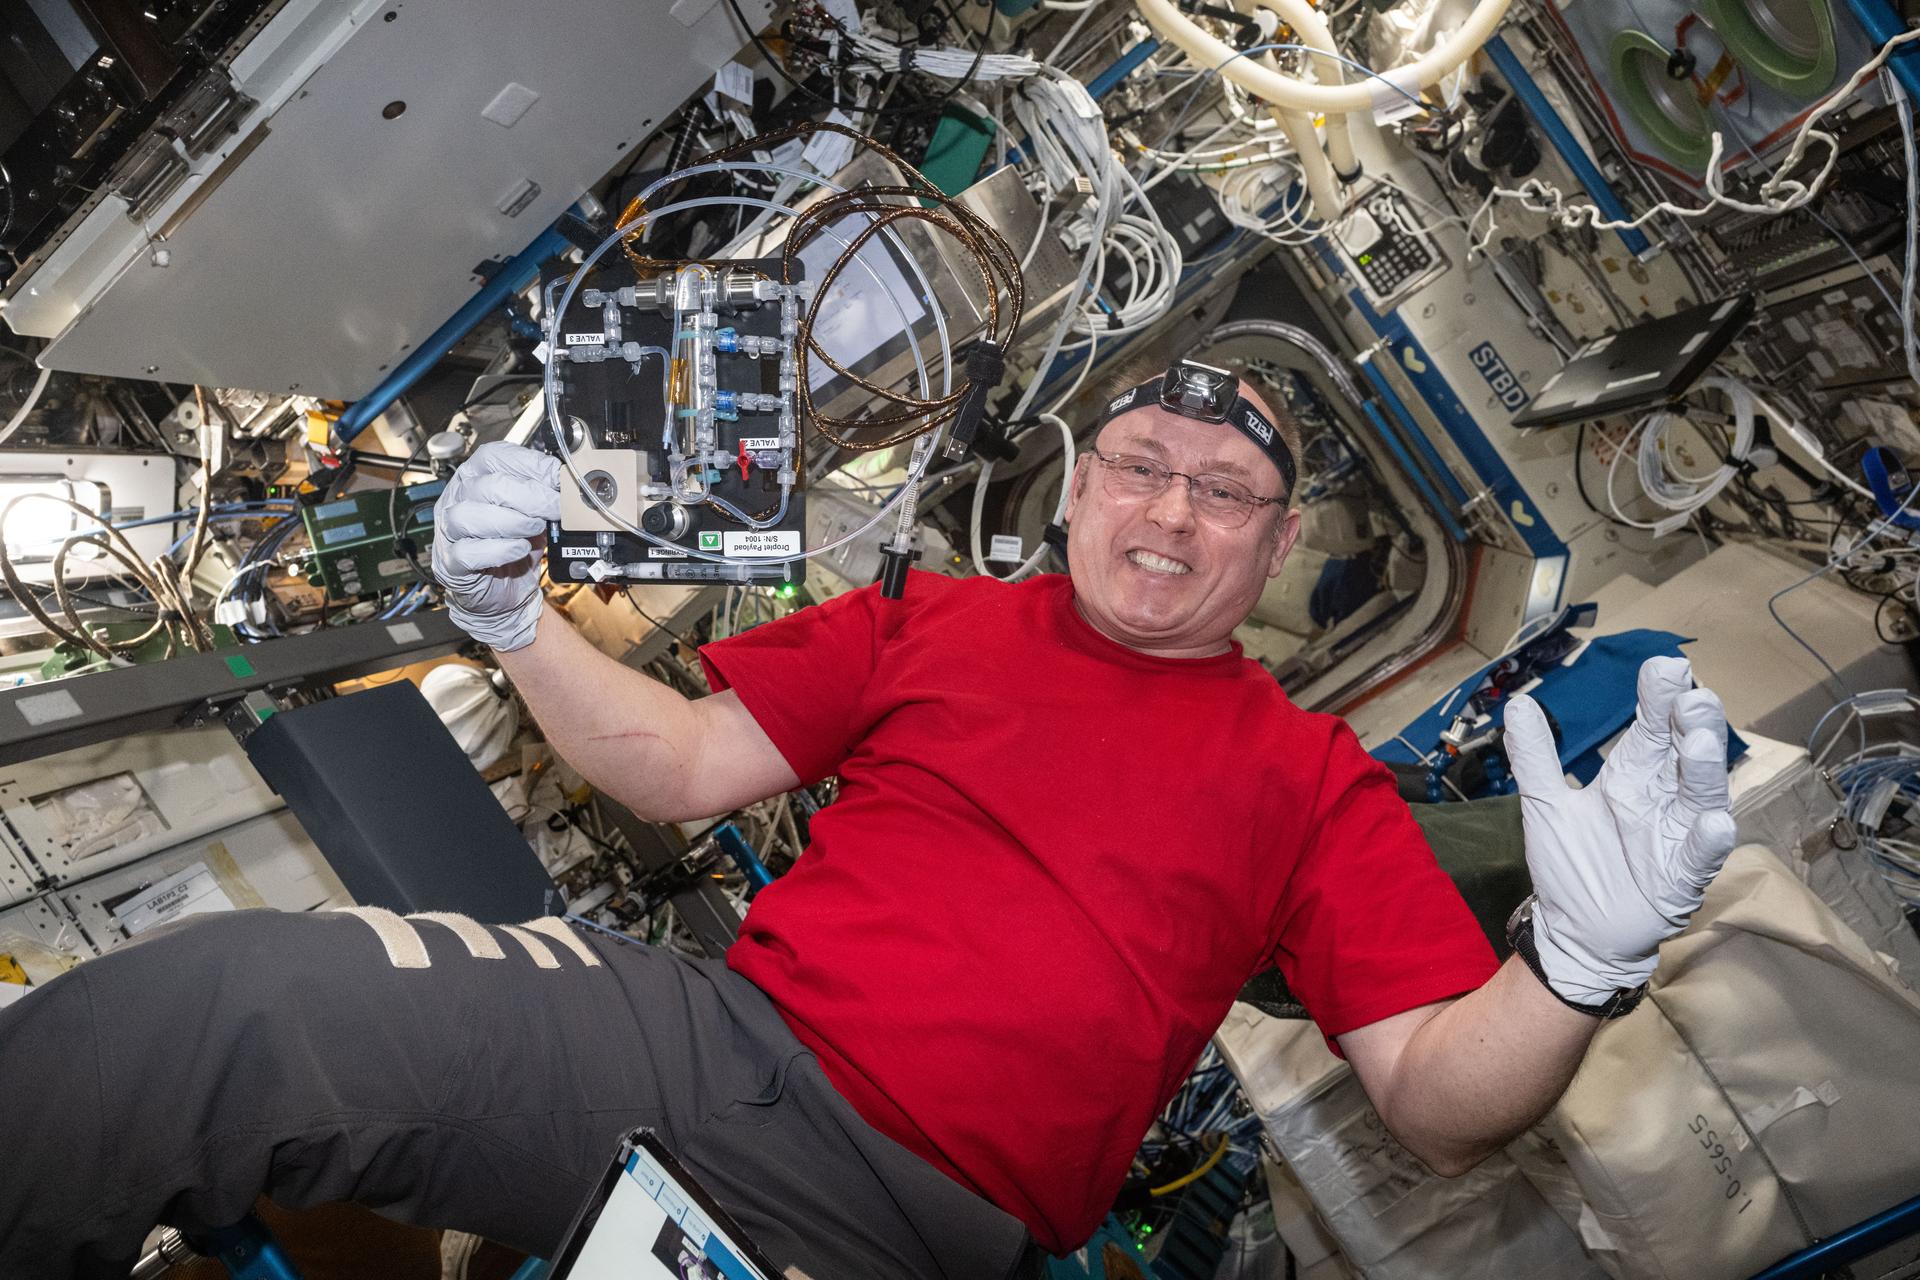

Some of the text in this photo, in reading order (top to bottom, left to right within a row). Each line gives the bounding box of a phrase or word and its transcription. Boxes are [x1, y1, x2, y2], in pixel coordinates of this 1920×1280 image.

[569, 335, 601, 343] VALVE 3
[1473, 346, 1525, 407] STBD
[1109, 387, 1137, 412] PETZL
[1245, 410, 1274, 445] PETZL
[749, 439, 776, 447] VALVE
[745, 535, 779, 543] S/N: 1004
[734, 543, 790, 552] Droplet Payload
[571, 548, 596, 556] VALVE
